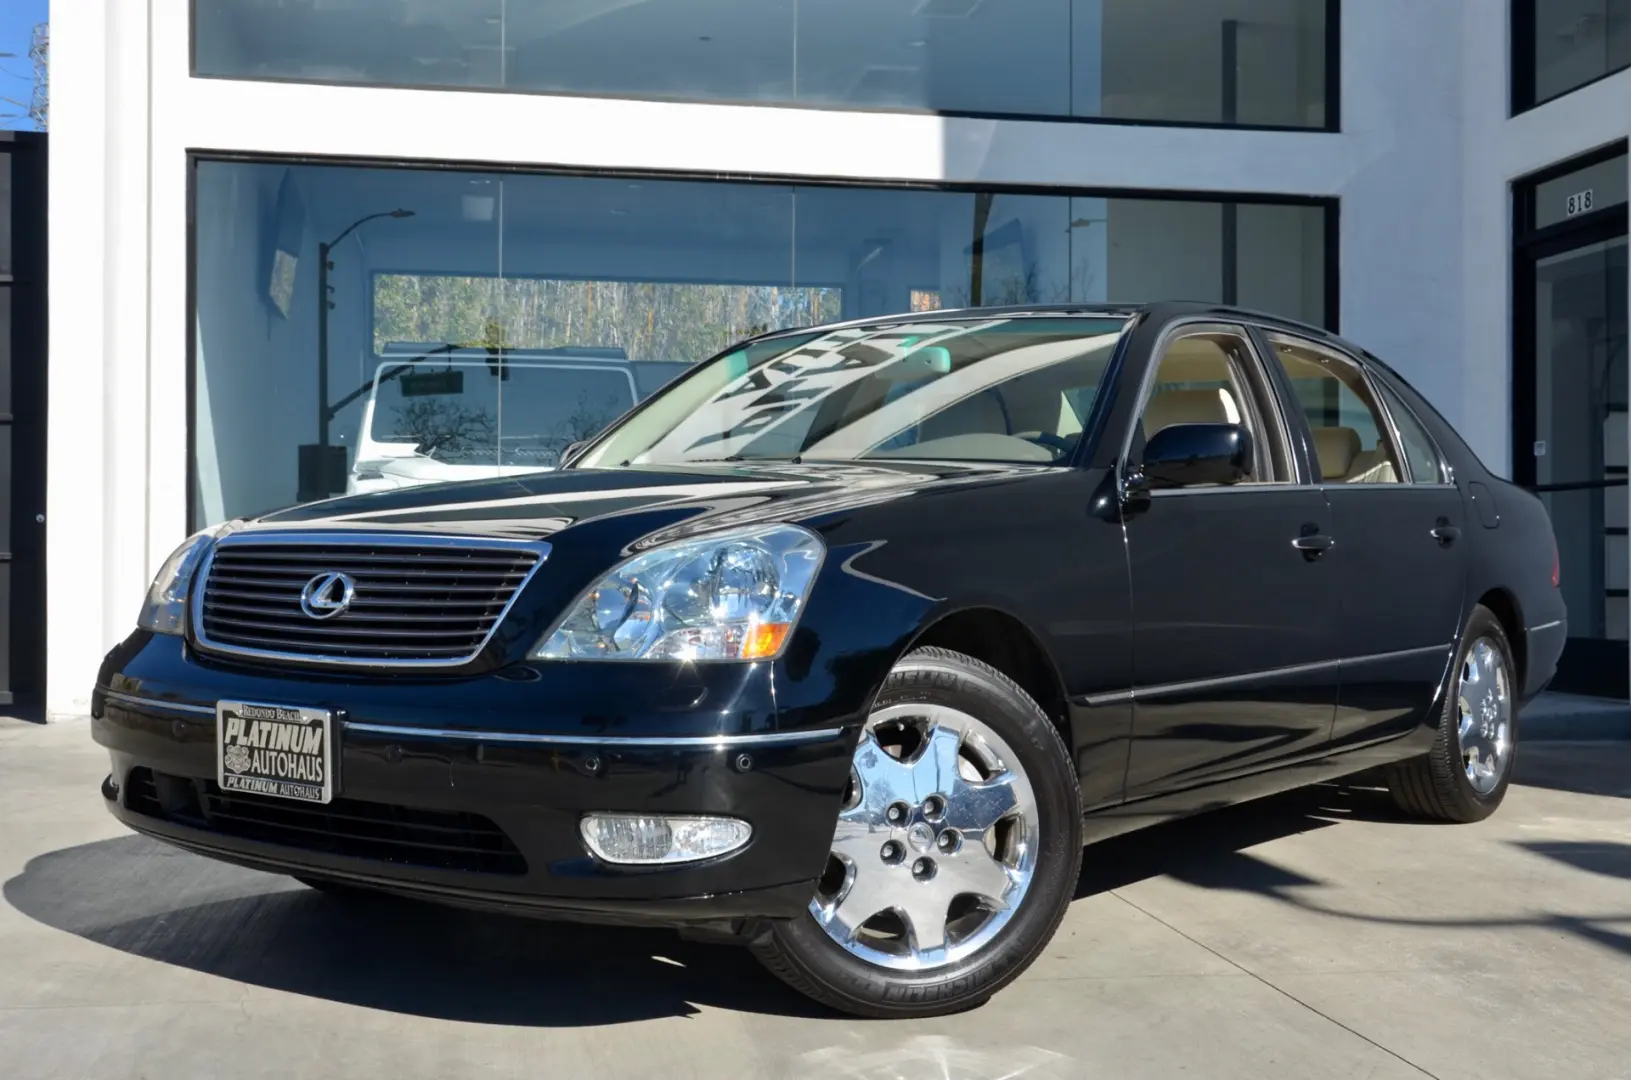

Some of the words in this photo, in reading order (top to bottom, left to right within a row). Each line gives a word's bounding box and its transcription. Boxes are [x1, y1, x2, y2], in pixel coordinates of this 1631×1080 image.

[1568, 191, 1592, 214] 818
[242, 704, 275, 719] REDONDO
[276, 707, 301, 721] BEACH
[224, 717, 323, 755] PLATINUM
[251, 749, 323, 782] AUTOHAUS
[227, 776, 278, 794] PLATINUM
[280, 785, 320, 800] AUTOHAUS
[885, 962, 994, 1002] MICHELIN
